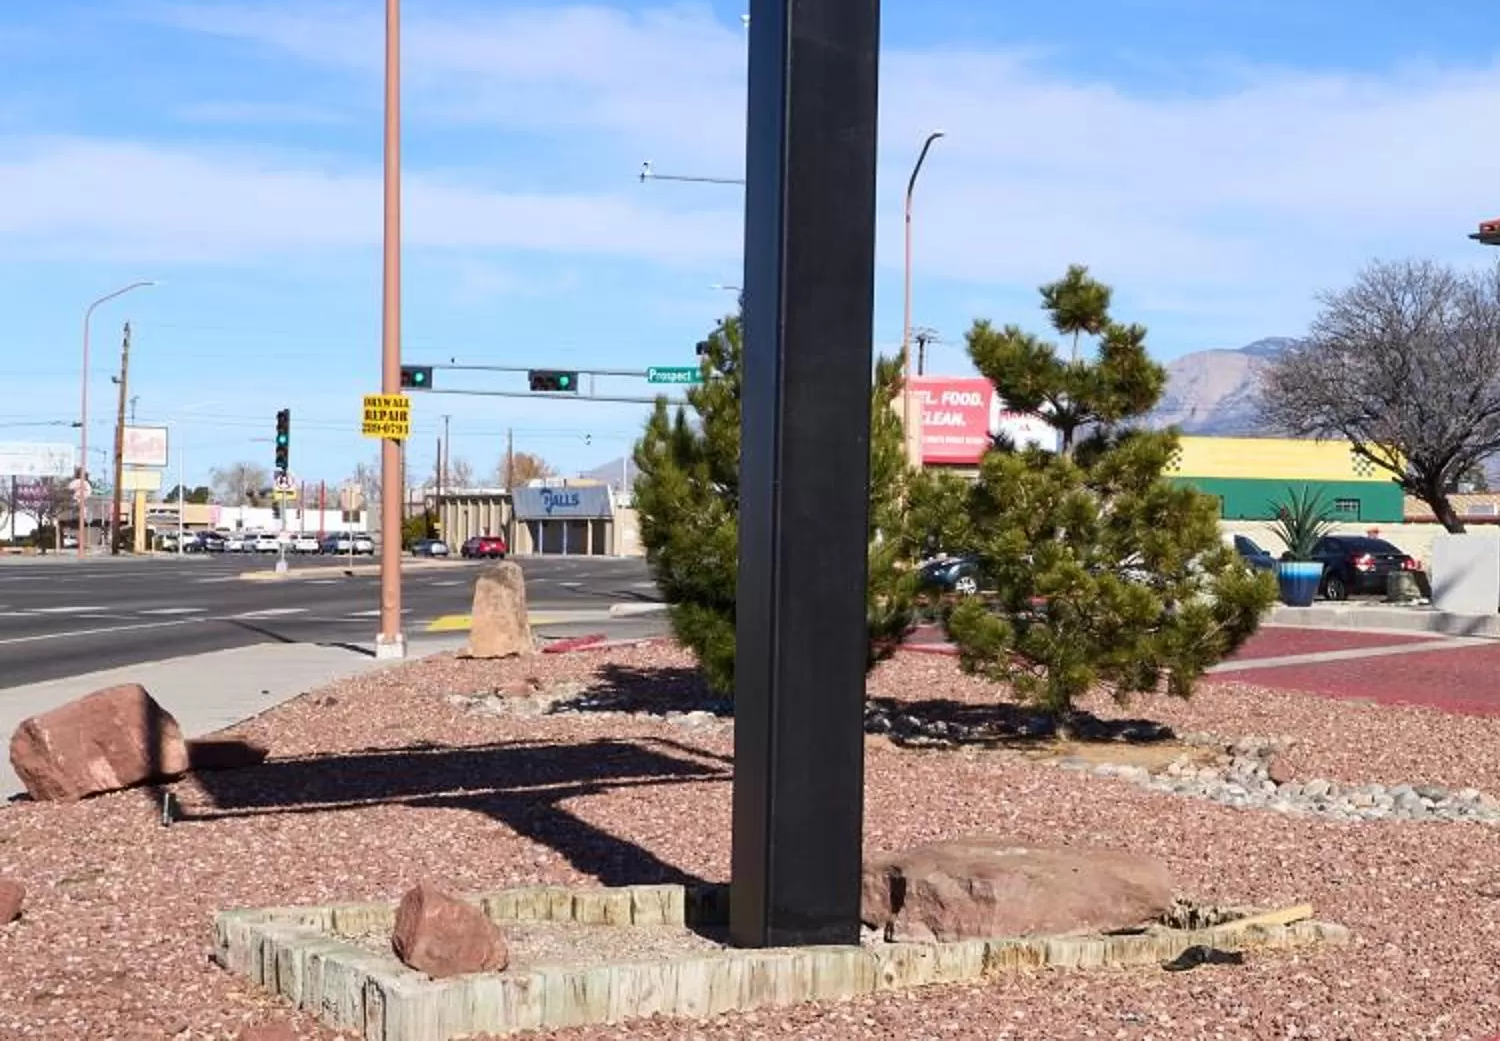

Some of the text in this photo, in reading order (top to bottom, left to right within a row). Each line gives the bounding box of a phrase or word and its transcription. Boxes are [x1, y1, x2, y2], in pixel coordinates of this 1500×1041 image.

[648, 368, 691, 383] Prospect
[363, 397, 409, 408] DRYWALL
[941, 391, 984, 407] FOOD.
[365, 410, 408, 421] REPAIR
